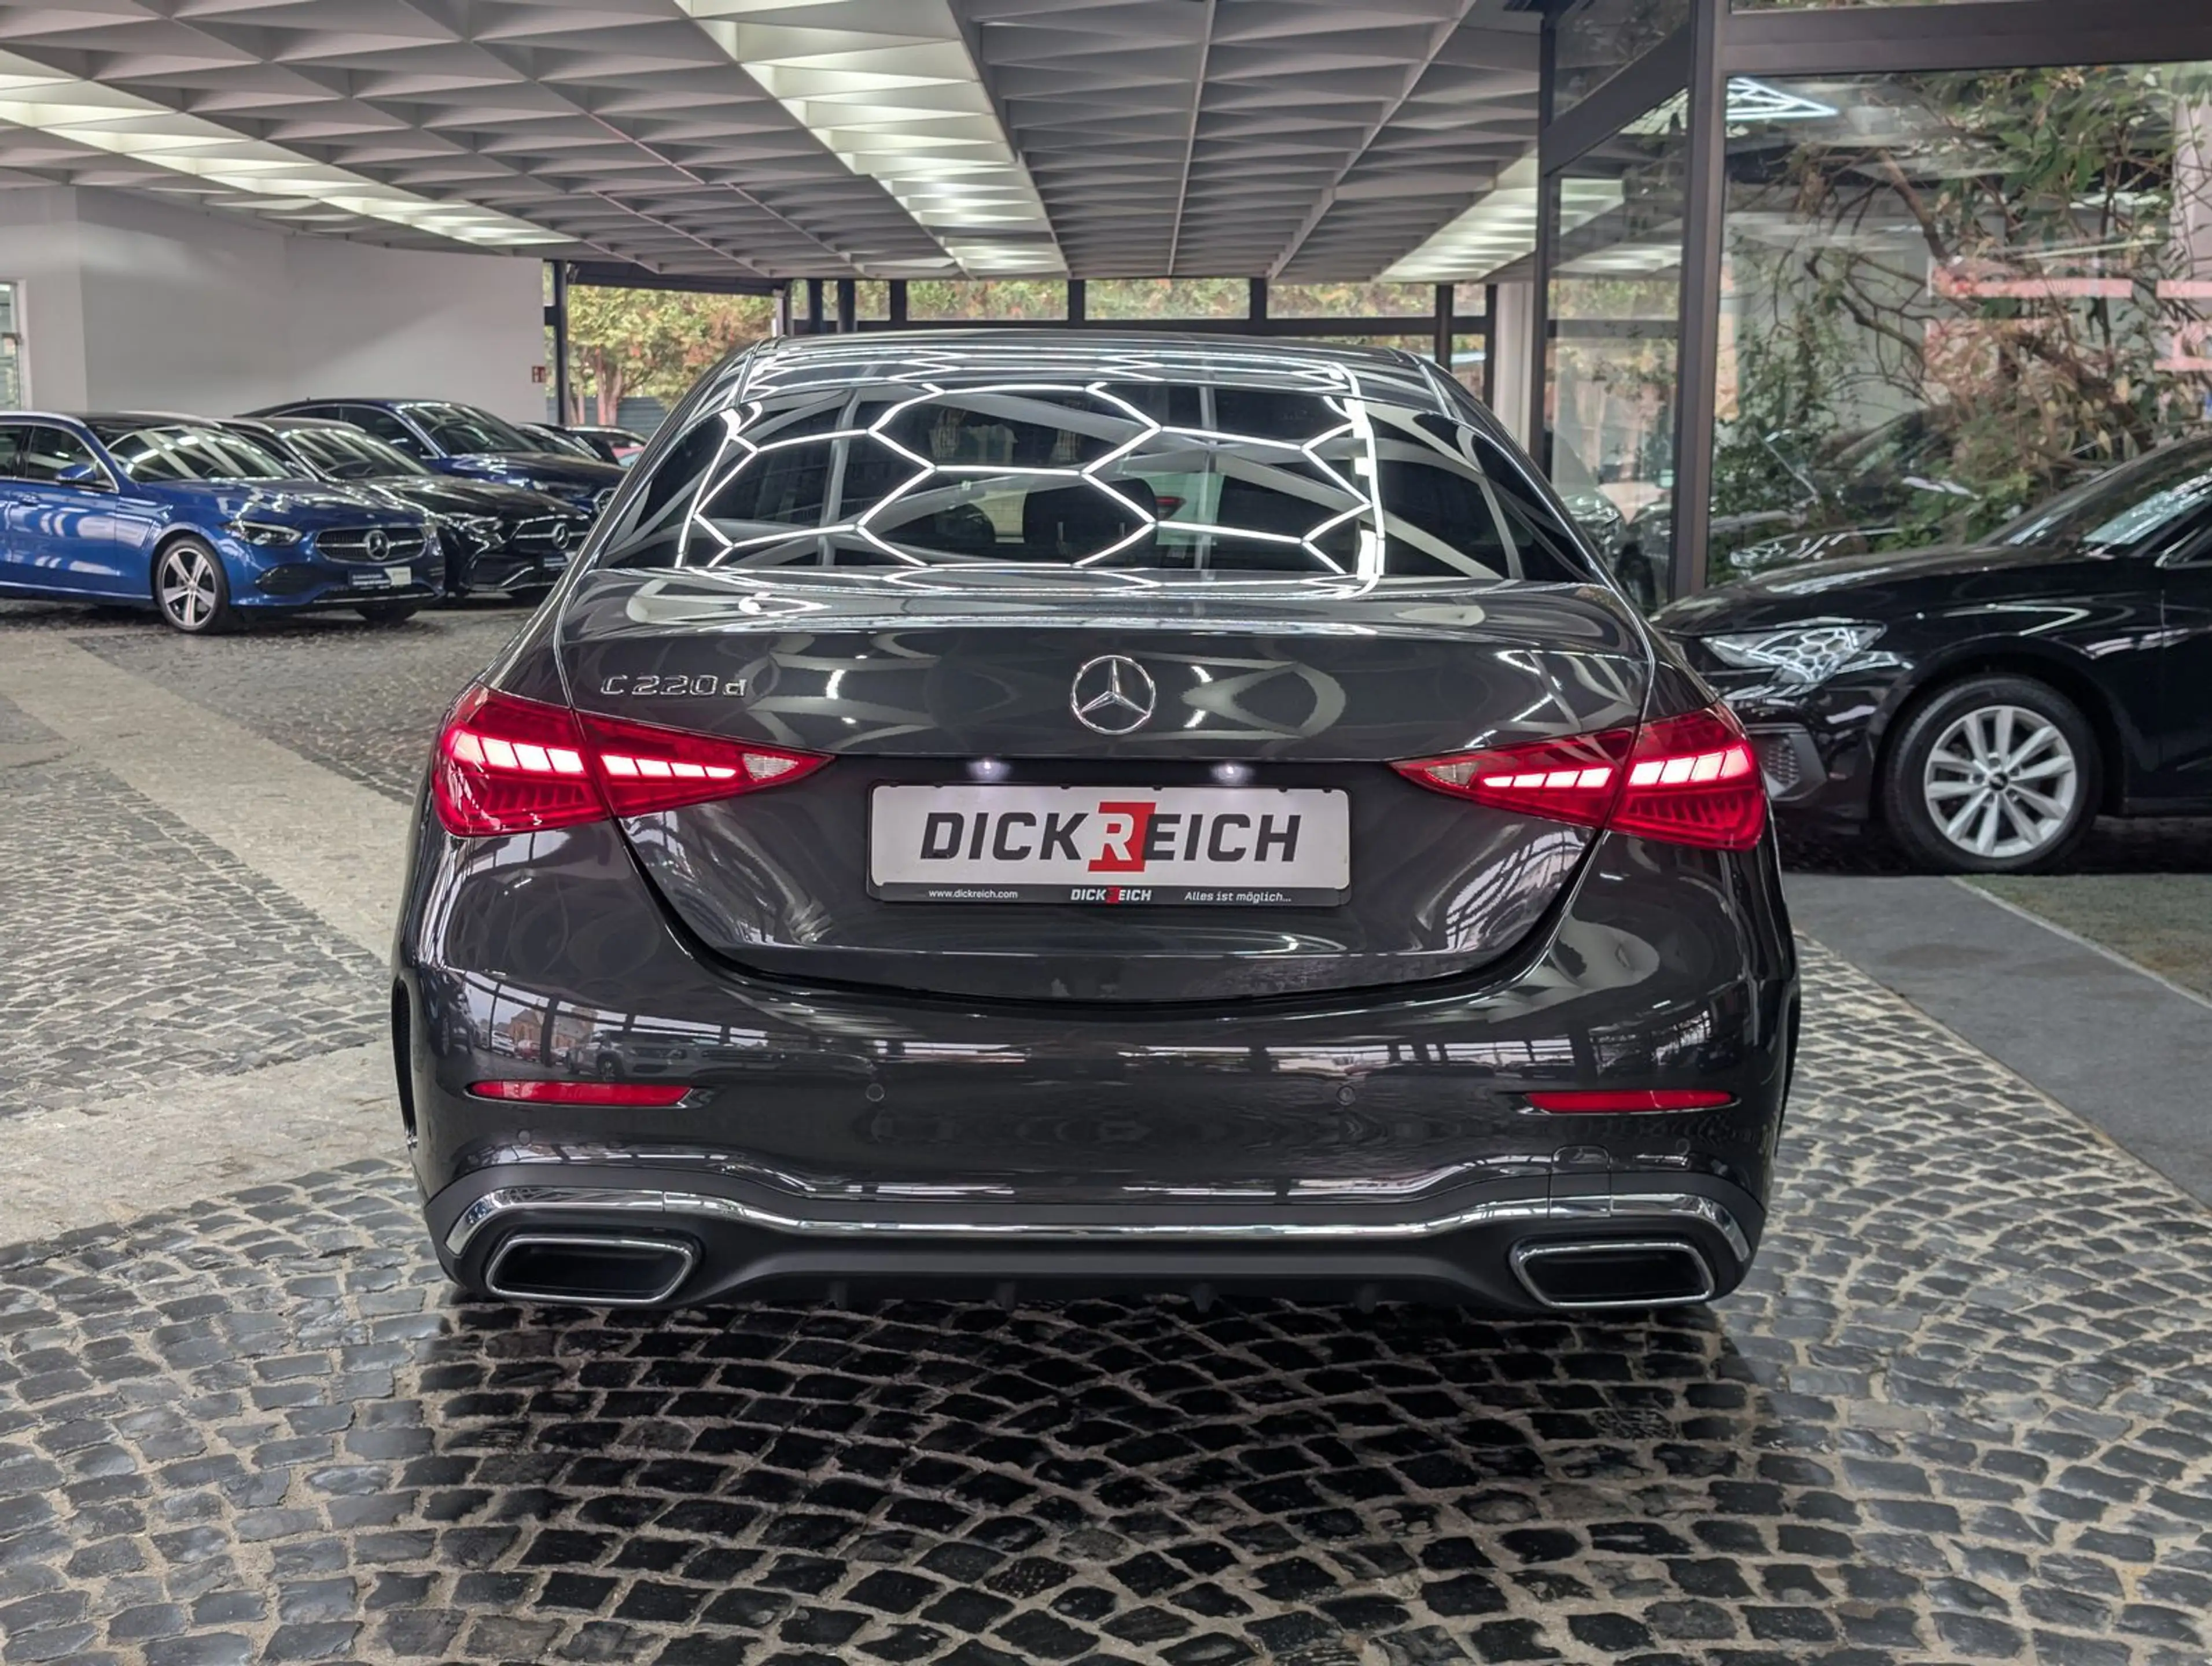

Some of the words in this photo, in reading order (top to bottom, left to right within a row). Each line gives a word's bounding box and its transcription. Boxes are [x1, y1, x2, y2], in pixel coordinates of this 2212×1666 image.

[928, 889, 1018, 899] www.dickreich.com
[1184, 891, 1214, 901] Alles
[1216, 891, 1234, 901] ist
